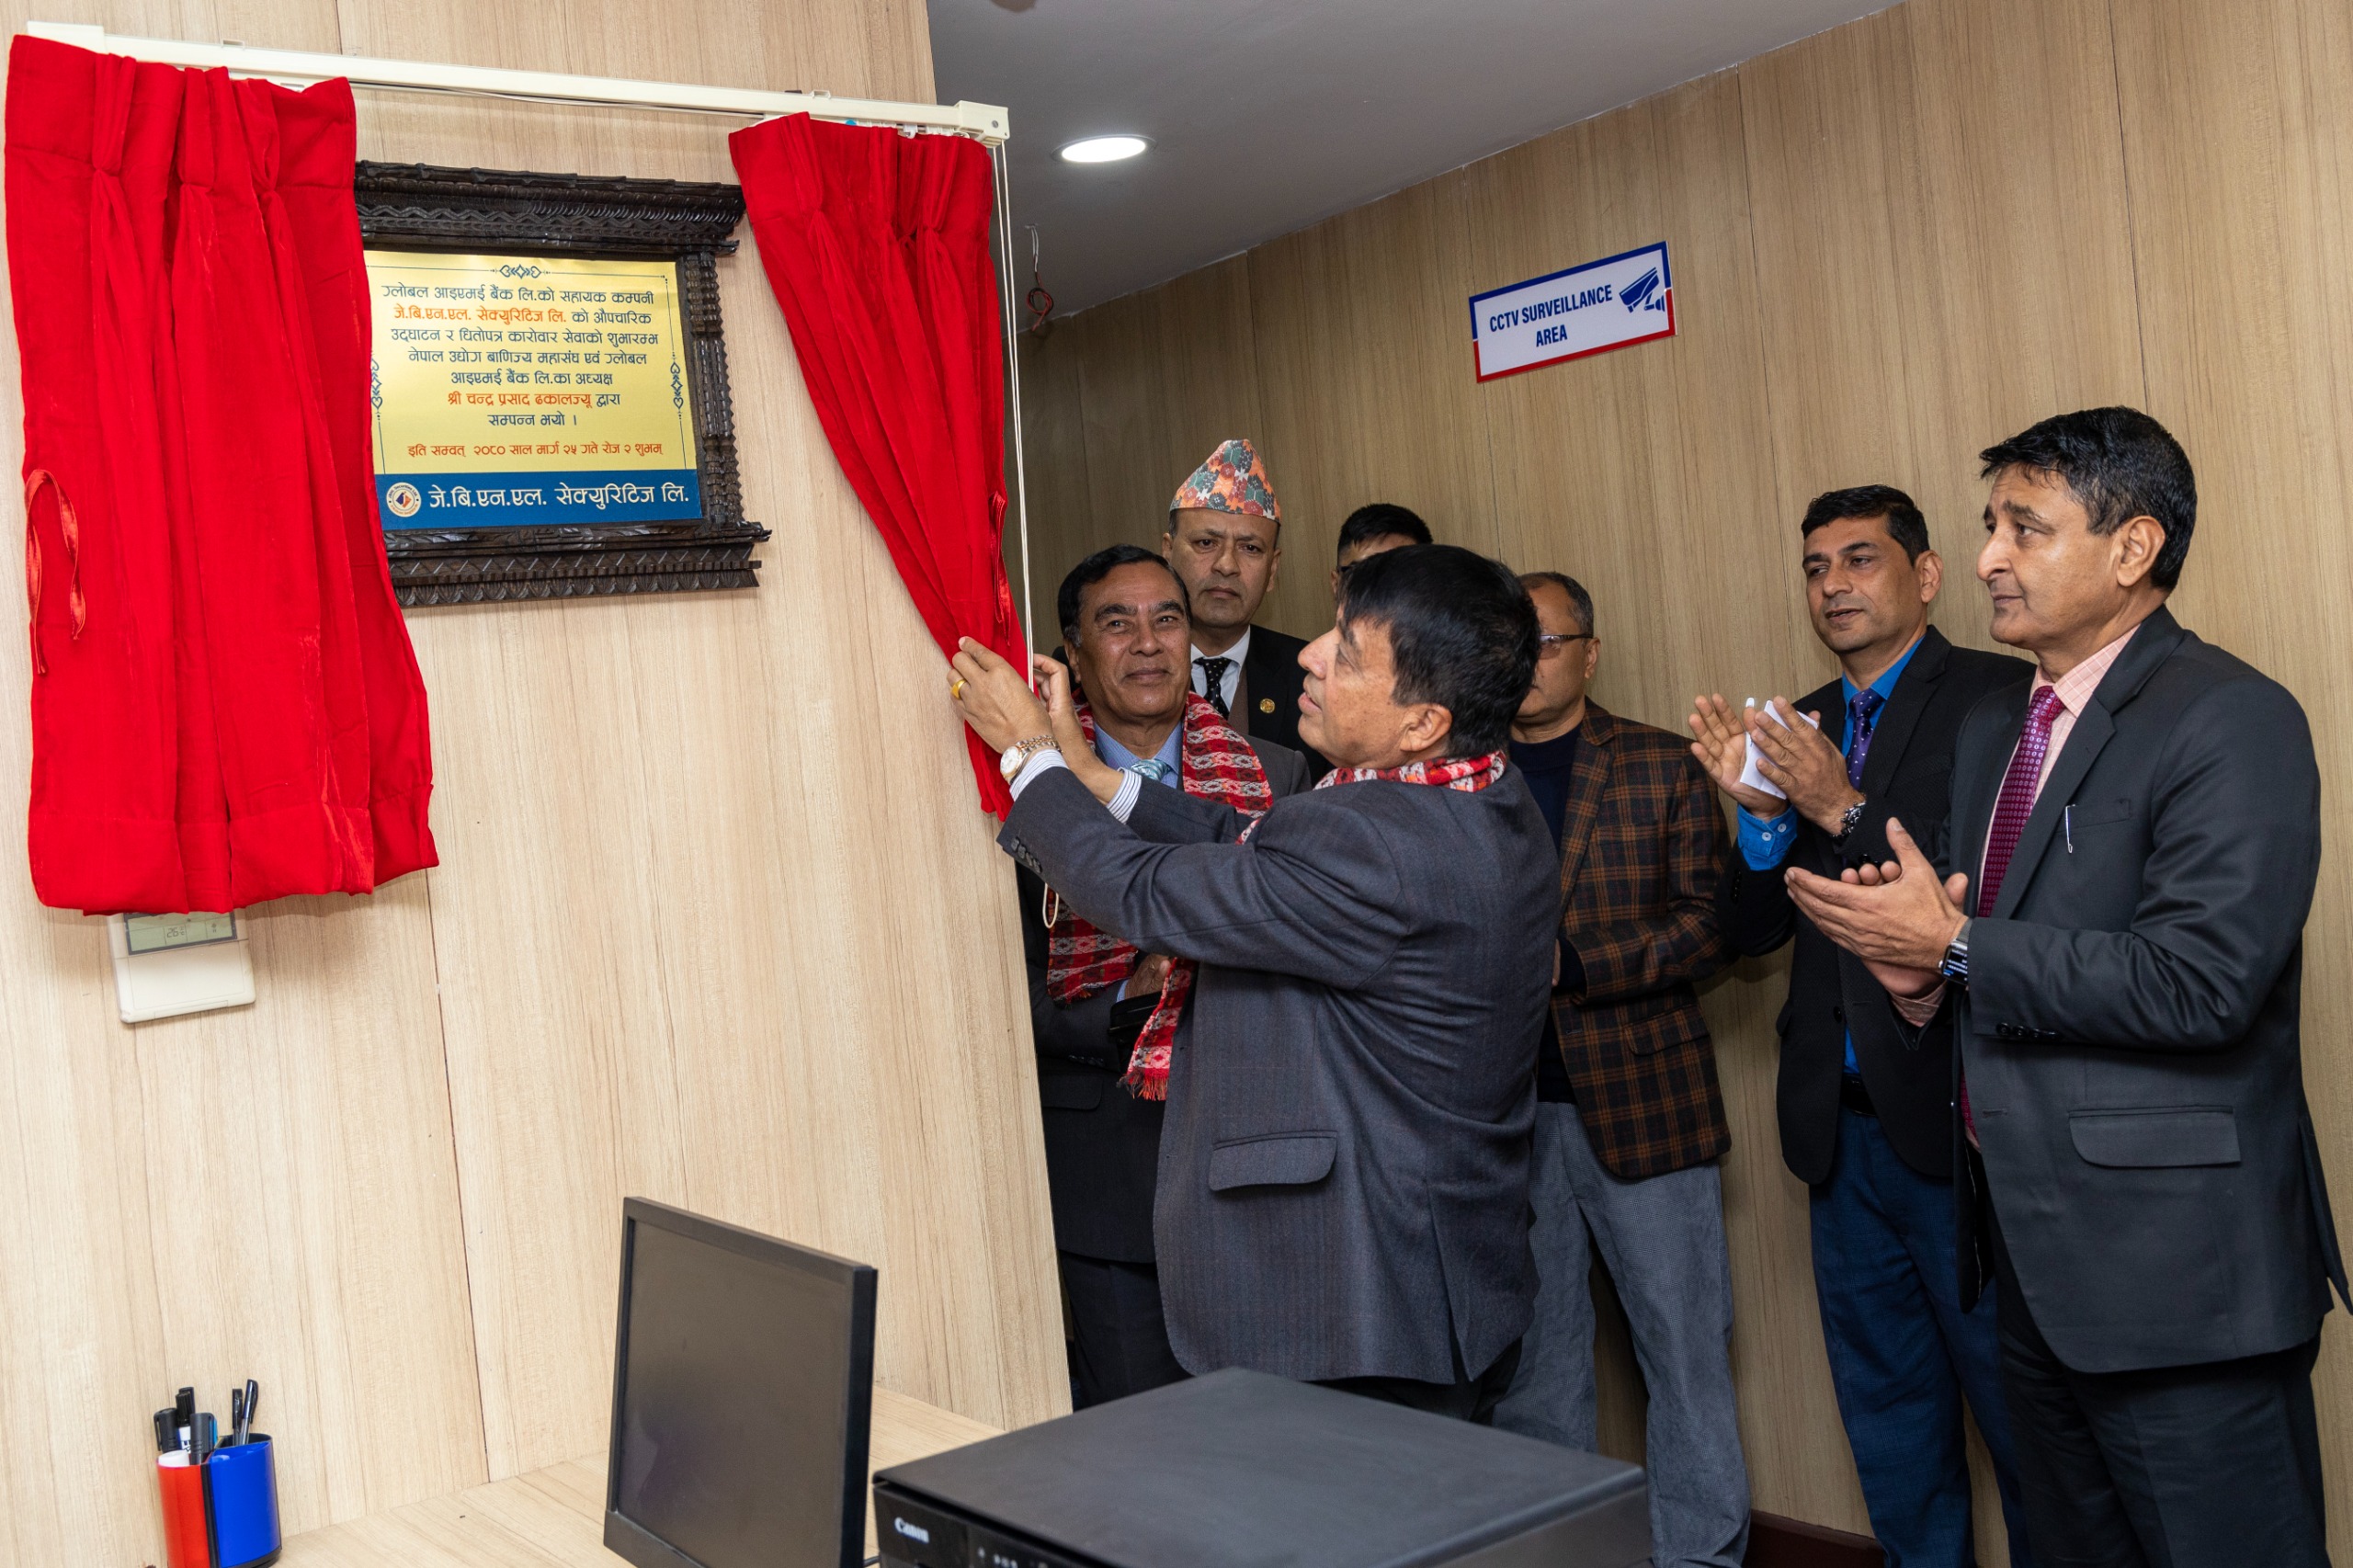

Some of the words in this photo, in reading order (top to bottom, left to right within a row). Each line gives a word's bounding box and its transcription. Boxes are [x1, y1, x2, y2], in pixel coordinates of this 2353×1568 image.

[381, 281, 428, 298] ग्लोबल
[434, 284, 485, 301] आइएमई
[490, 284, 514, 301] बैंक
[518, 287, 555, 301] लि.को
[559, 290, 607, 303] सहायक
[611, 290, 654, 304] कम्पनी
[393, 303, 472, 321] जे.बि.एन.एल.
[476, 305, 543, 325] सेक्युरिटिज
[548, 308, 566, 323] लि.
[571, 308, 589, 323] को
[593, 308, 652, 324] औपचारिक
[1522, 284, 1613, 324] SURVEILLANCE
[1489, 309, 1519, 333] CCTV
[446, 329, 455, 341] र
[507, 327, 558, 343] कारोवार
[563, 328, 603, 345] सेवाको
[607, 332, 659, 347] शुभारम्भ
[1536, 324, 1568, 347] AREA
[408, 346, 444, 363] नेपाल
[449, 347, 483, 363] उद्योग
[486, 348, 533, 364] बाणिज्य
[537, 350, 580, 365] महासंघ
[584, 350, 601, 365] एवं
[604, 349, 647, 365] ग्लोबल
[450, 369, 503, 385] आइएमई
[506, 368, 530, 384] बैंक
[534, 369, 571, 384] लि.का
[448, 391, 461, 405] श्री
[466, 392, 494, 406] चन्द्र
[498, 392, 530, 406] प्रसाद
[596, 393, 621, 408] द्वारा
[487, 415, 536, 426] सम्पन्न
[540, 410, 565, 426] भयो
[406, 443, 427, 458] इति
[430, 445, 467, 458] सम्वत्
[473, 445, 506, 456] २०८०
[509, 444, 532, 456] साल
[536, 440, 561, 455] मार्ग
[563, 444, 577, 455] २५
[580, 441, 598, 454] गते
[601, 440, 620, 454] रोज
[623, 444, 631, 454] २
[634, 442, 664, 457] शुभम्
[428, 483, 548, 508] जे.बि.एन.एल.
[554, 482, 655, 510] सेक्युरिटिज
[660, 482, 689, 504] लि.
